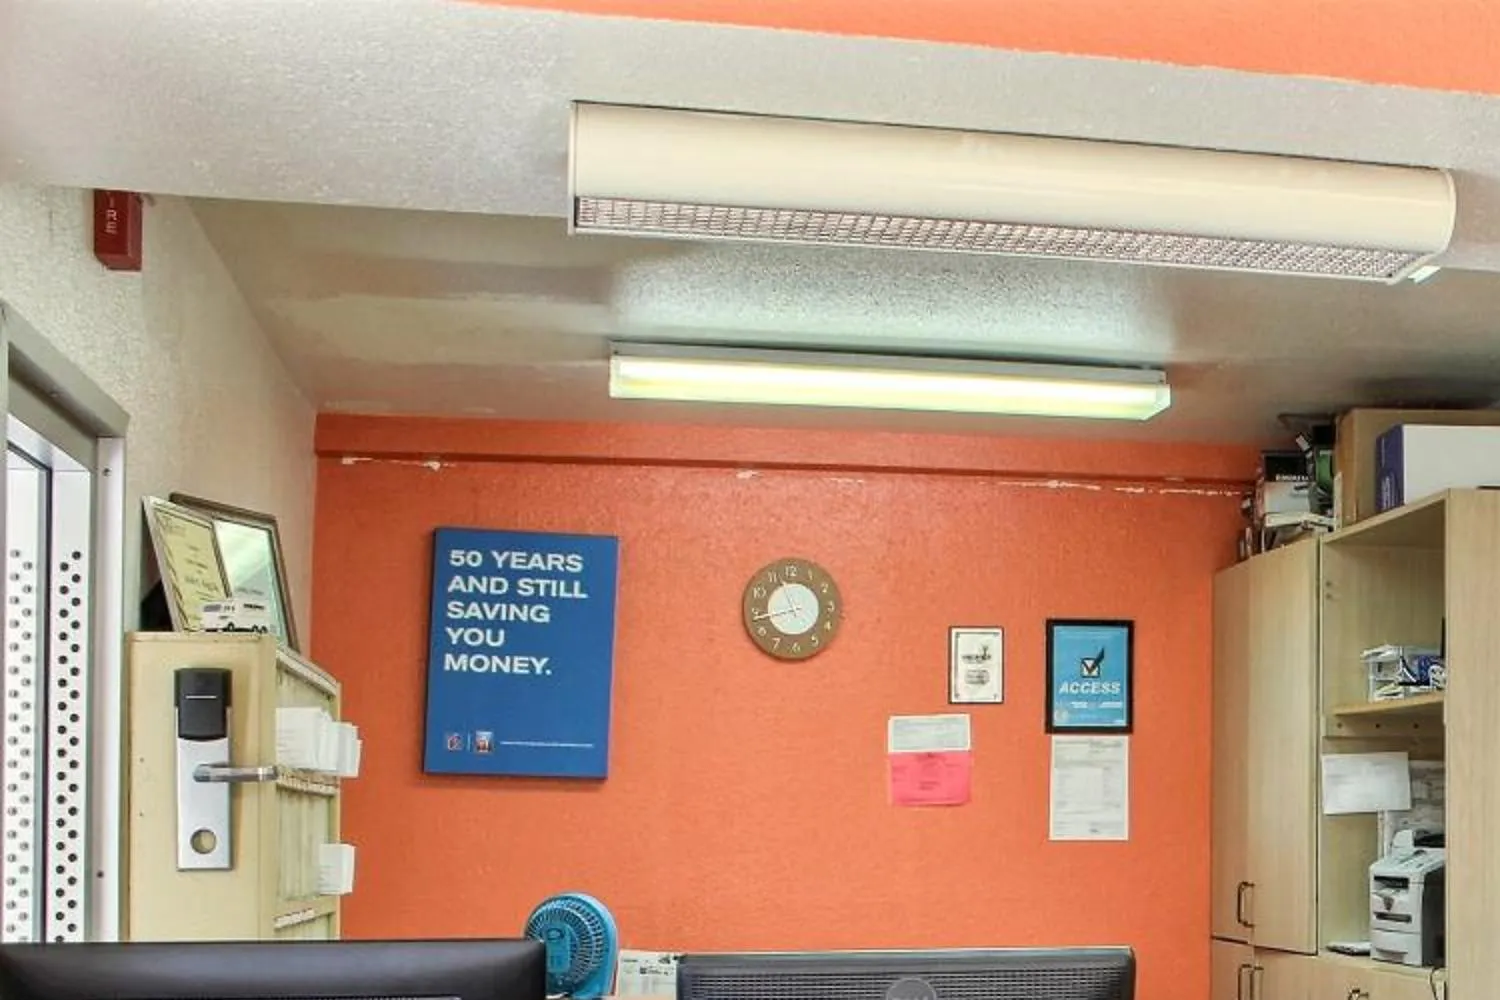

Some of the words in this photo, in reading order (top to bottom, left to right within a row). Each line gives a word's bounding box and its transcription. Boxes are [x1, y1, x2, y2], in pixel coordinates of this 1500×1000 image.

[104, 190, 118, 234] IRE
[450, 549, 483, 567] 50
[491, 550, 584, 573] YEARS
[785, 565, 798, 577] 12
[447, 575, 509, 594] AND
[517, 577, 588, 599] STILL
[446, 600, 551, 623] SAVING
[444, 627, 506, 647] YOU
[443, 653, 553, 676] MONEY.
[1058, 681, 1121, 695] ACCESS
